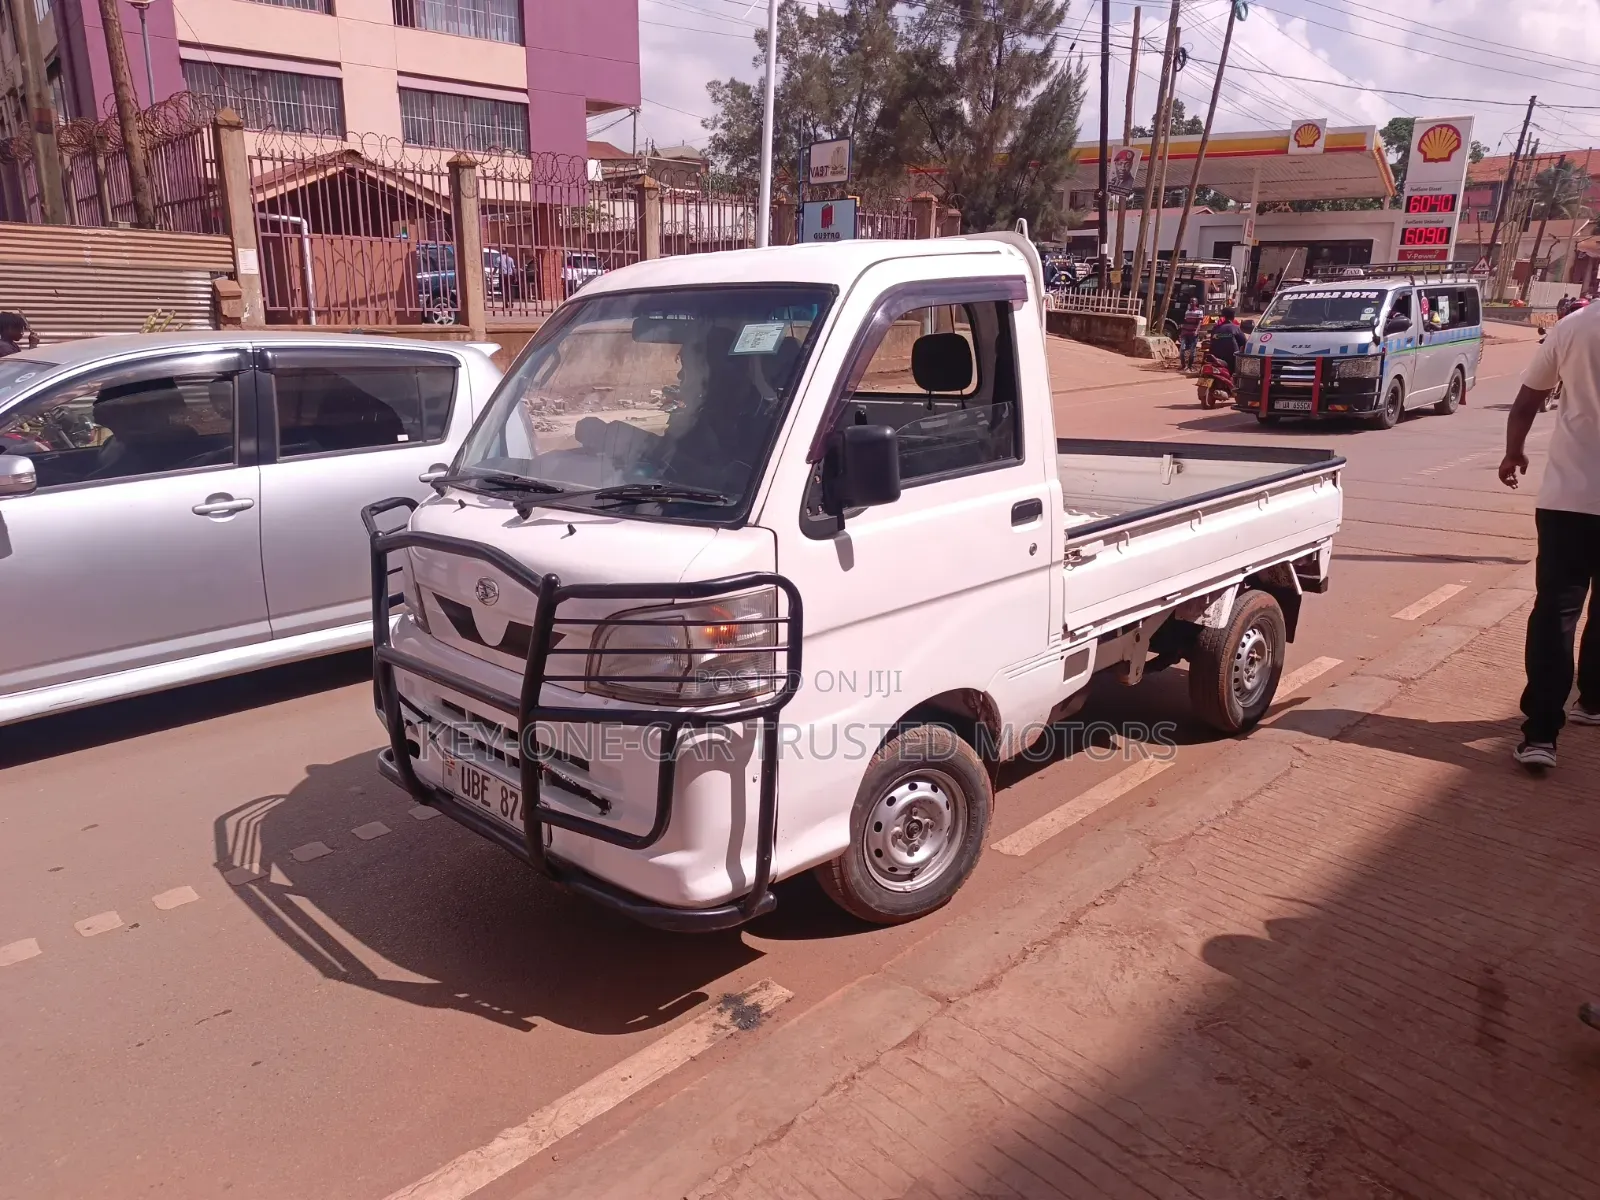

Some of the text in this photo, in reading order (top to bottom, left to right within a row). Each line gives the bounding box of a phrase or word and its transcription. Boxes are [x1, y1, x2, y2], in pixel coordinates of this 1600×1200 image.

[1409, 195, 1452, 213] 6040
[1405, 227, 1448, 246] 6090
[1283, 291, 1341, 300] CAPABLE
[461, 765, 524, 822] UBE 87
